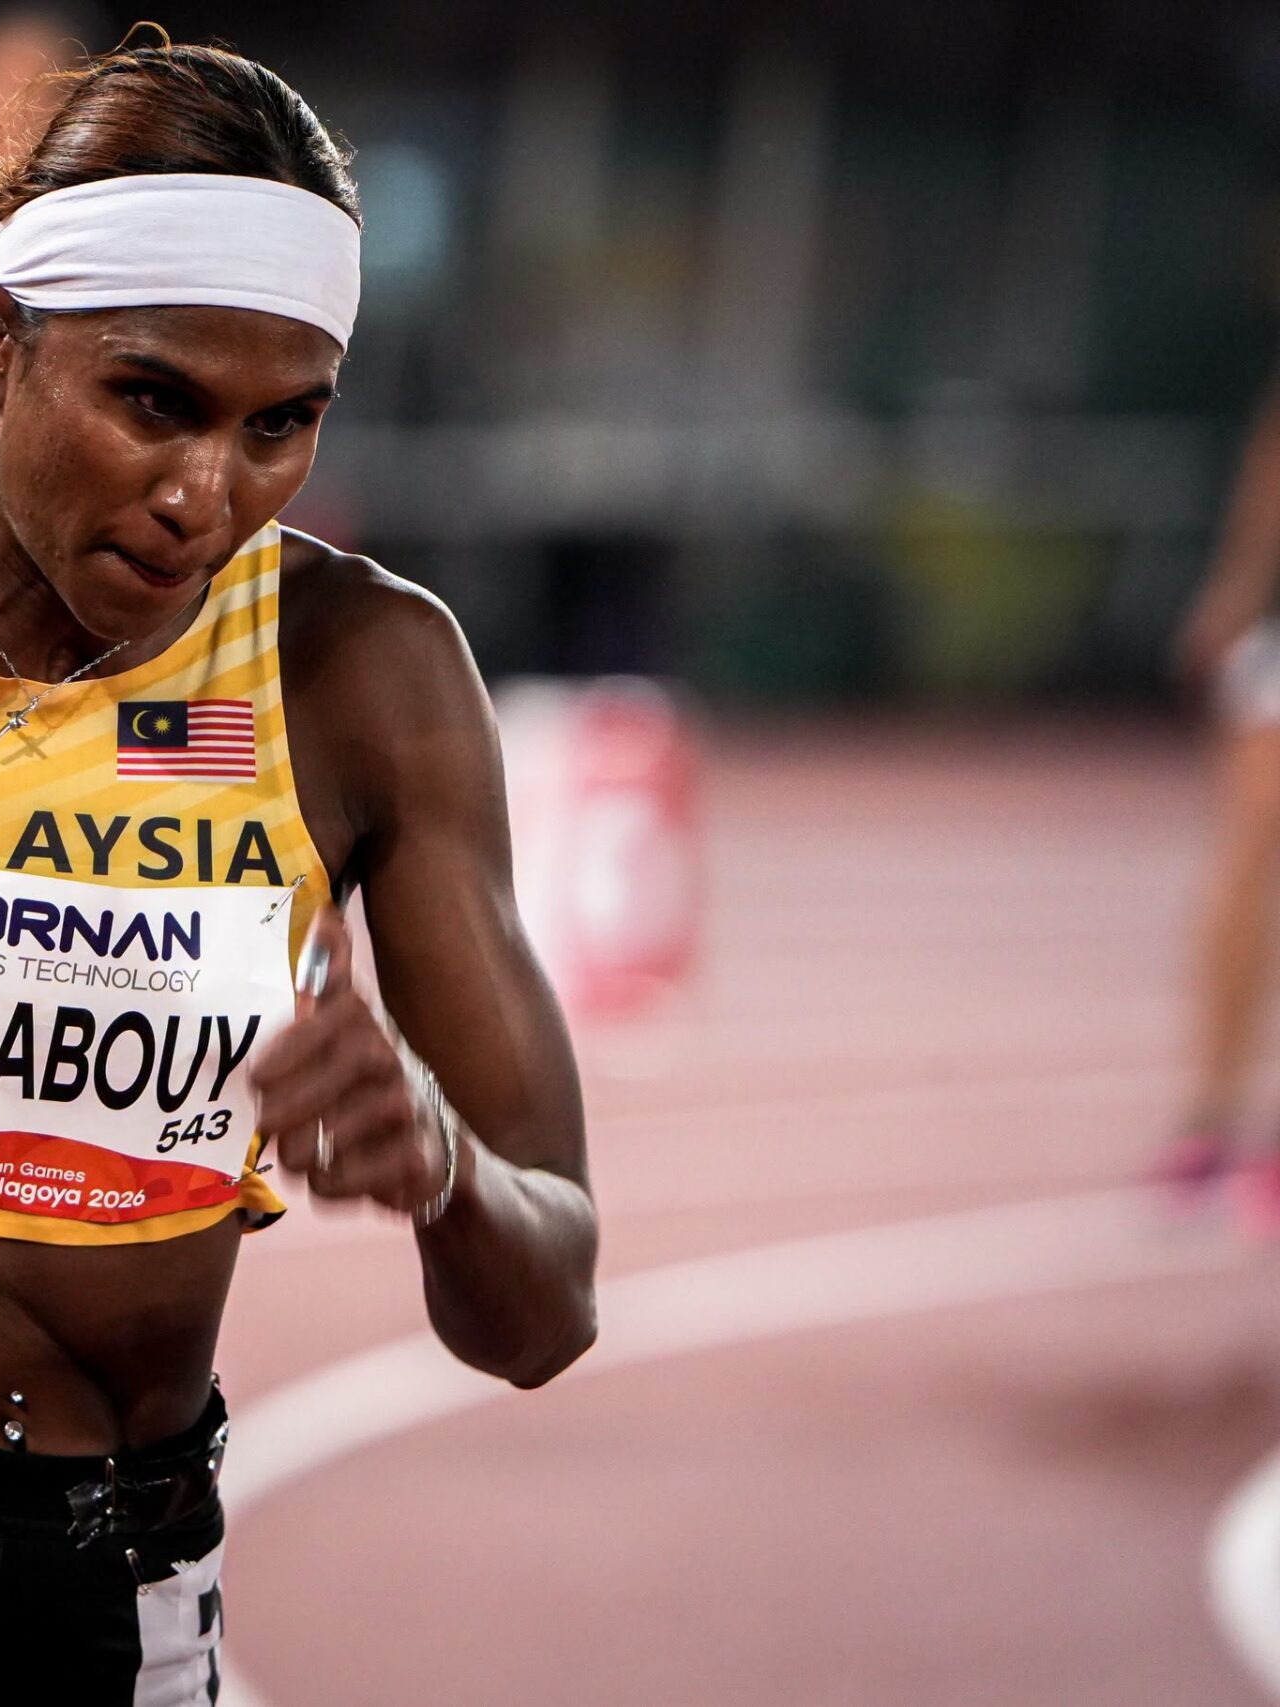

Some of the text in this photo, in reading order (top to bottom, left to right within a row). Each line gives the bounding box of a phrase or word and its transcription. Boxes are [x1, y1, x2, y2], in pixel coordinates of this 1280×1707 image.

[17, 956, 201, 993] TECHNOLOGY
[156, 1109, 232, 1153] 543
[20, 1162, 86, 1183] Games
[87, 1189, 146, 1209] 2026
